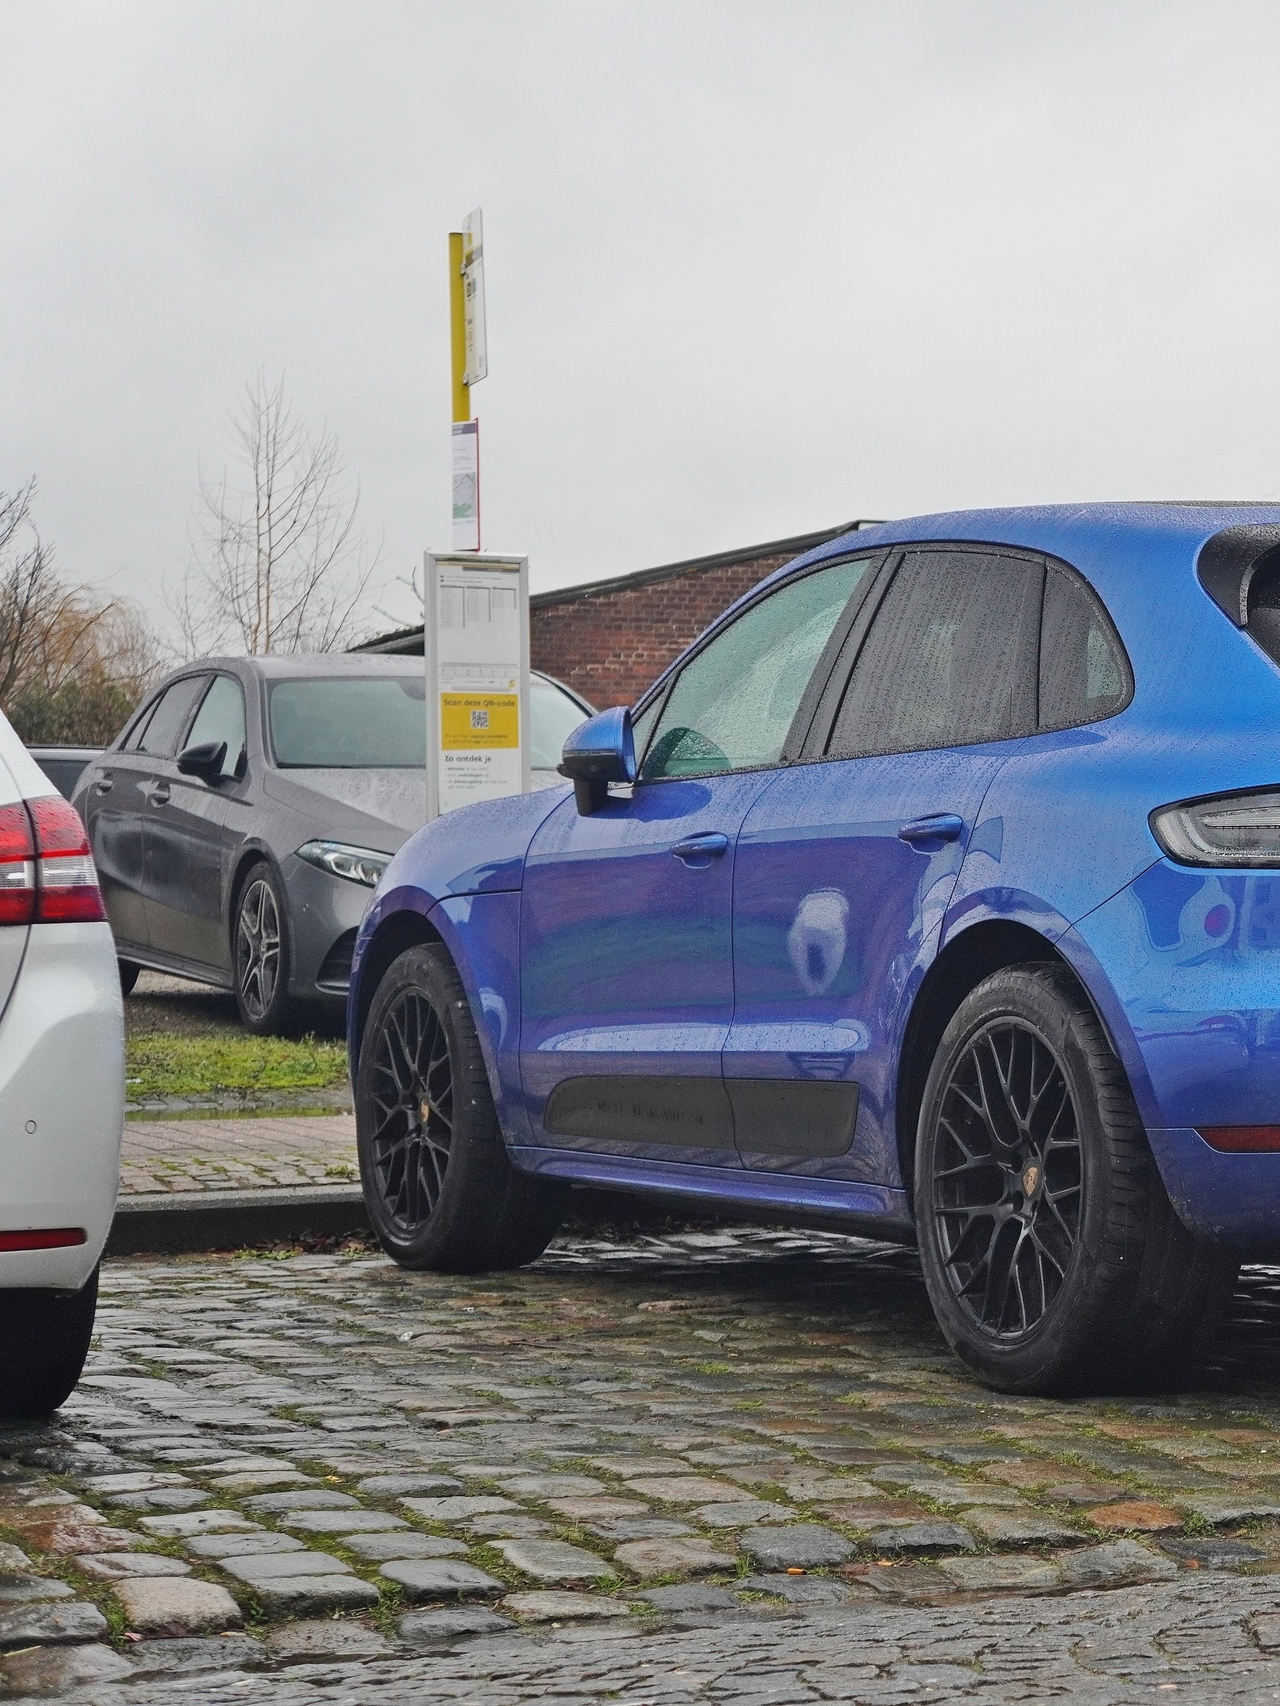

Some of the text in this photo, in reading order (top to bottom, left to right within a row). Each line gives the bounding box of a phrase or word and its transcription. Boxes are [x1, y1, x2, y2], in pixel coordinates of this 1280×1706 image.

[464, 699, 481, 707] deze
[483, 700, 515, 708] QR-code
[444, 755, 492, 764] Zo ontdek je
